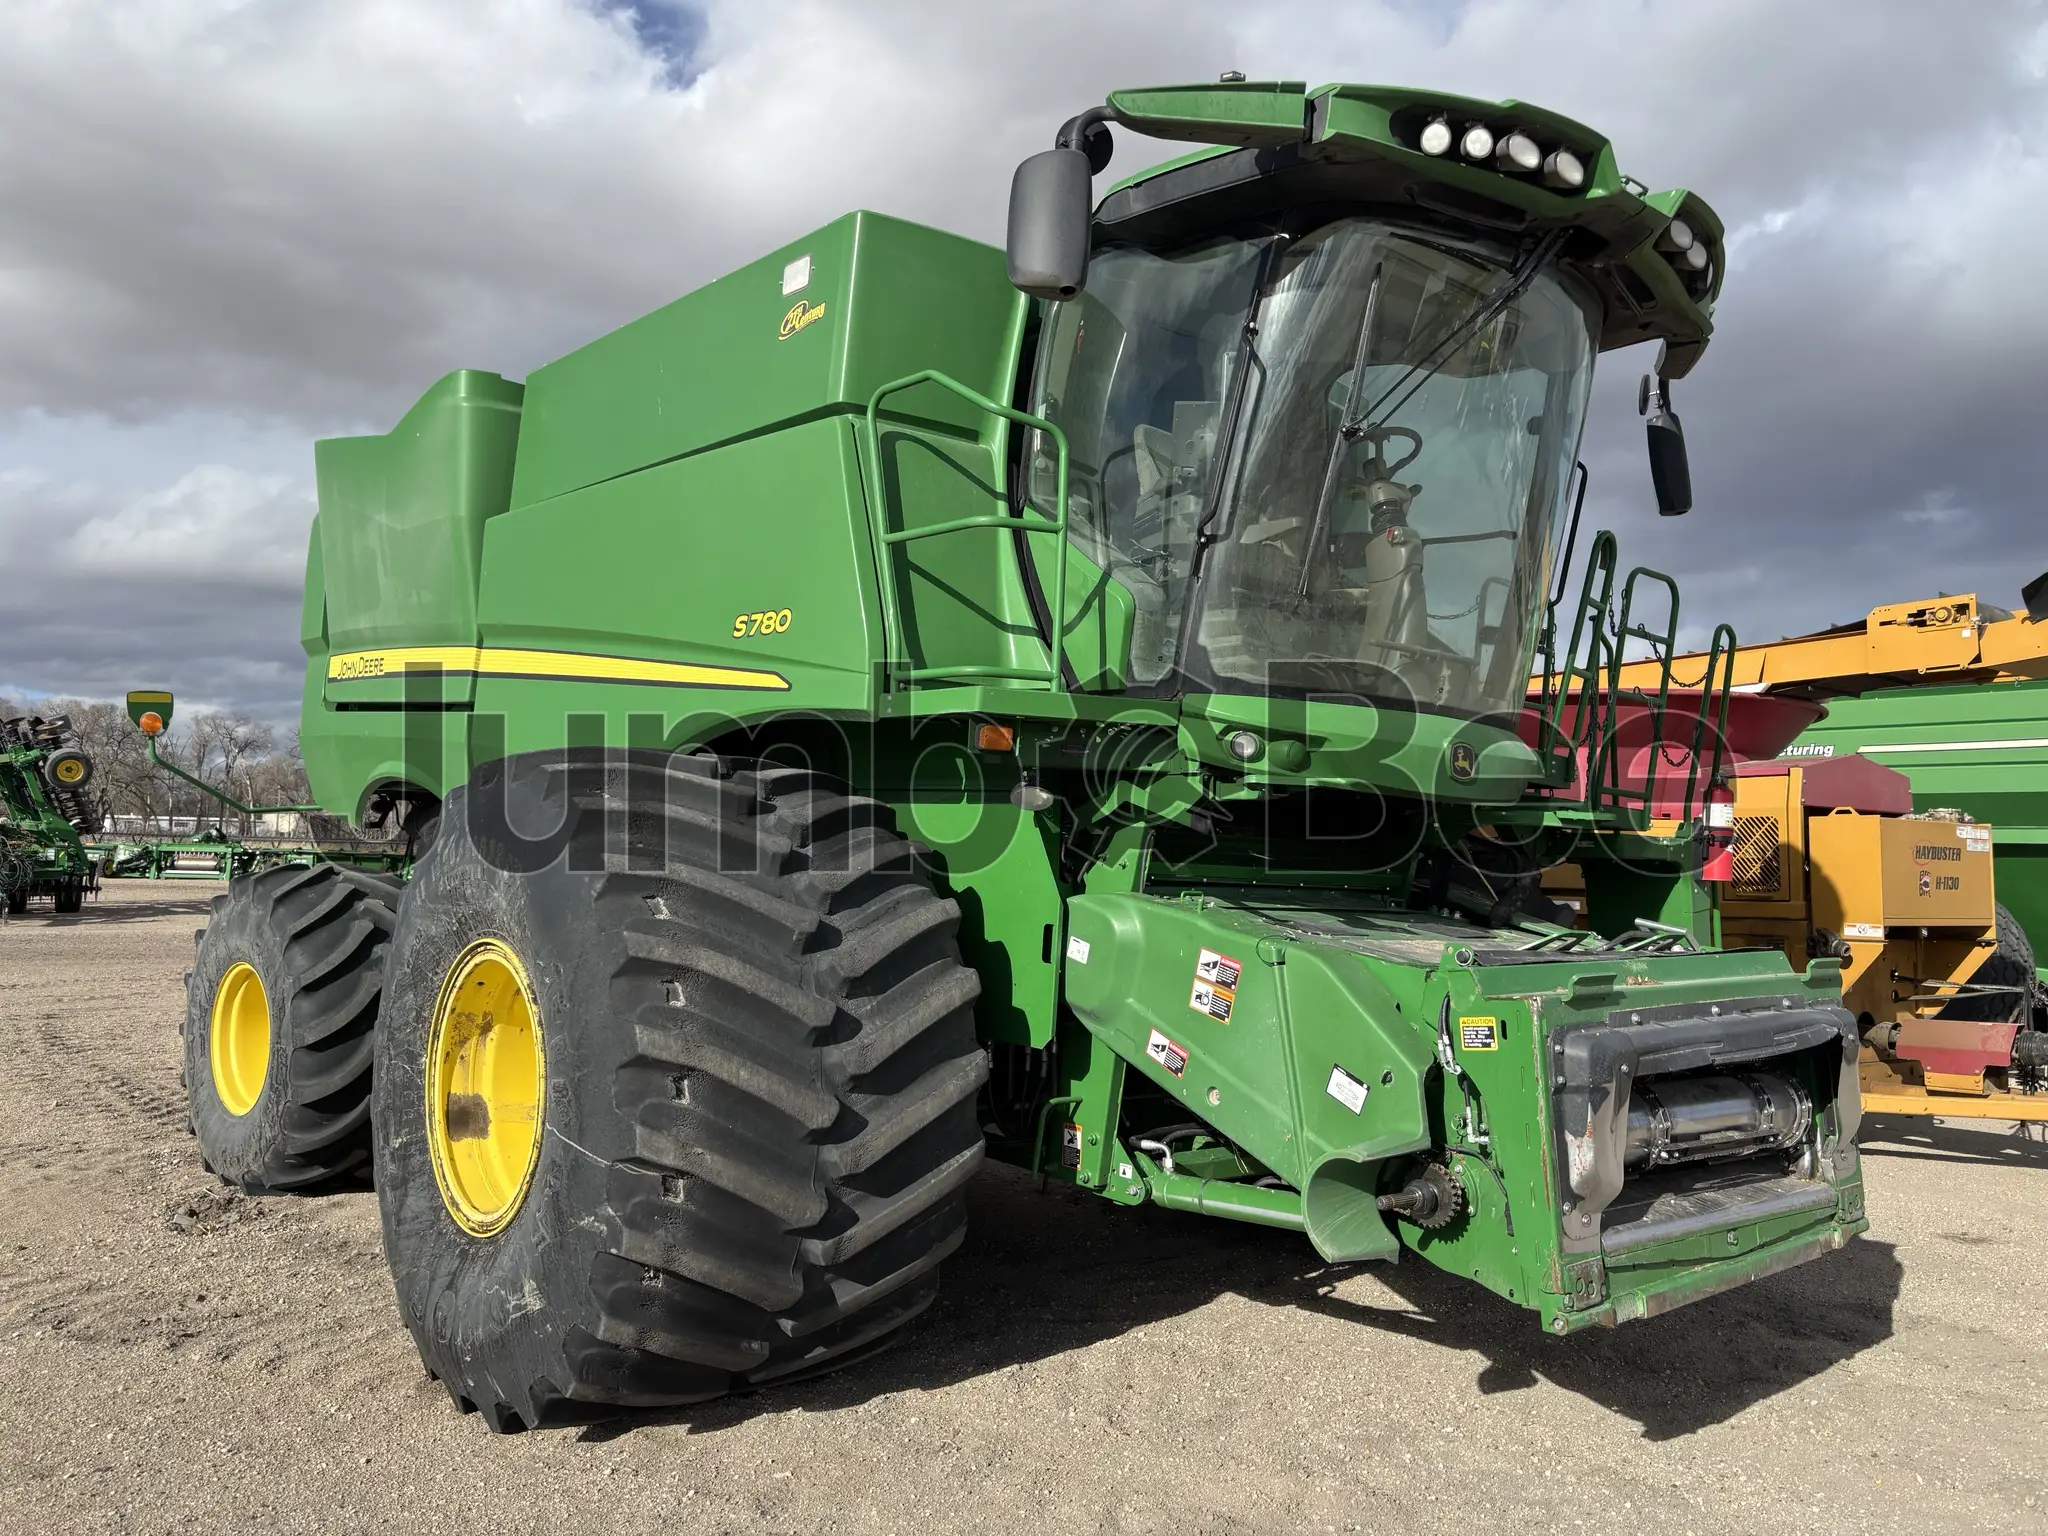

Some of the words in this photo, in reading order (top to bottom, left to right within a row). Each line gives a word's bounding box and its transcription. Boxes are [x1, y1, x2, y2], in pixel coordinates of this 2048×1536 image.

[732, 607, 793, 639] S780
[337, 659, 358, 678] JOHN
[358, 656, 385, 675] DEERE
[1915, 845, 1962, 862] HAYBUSTER
